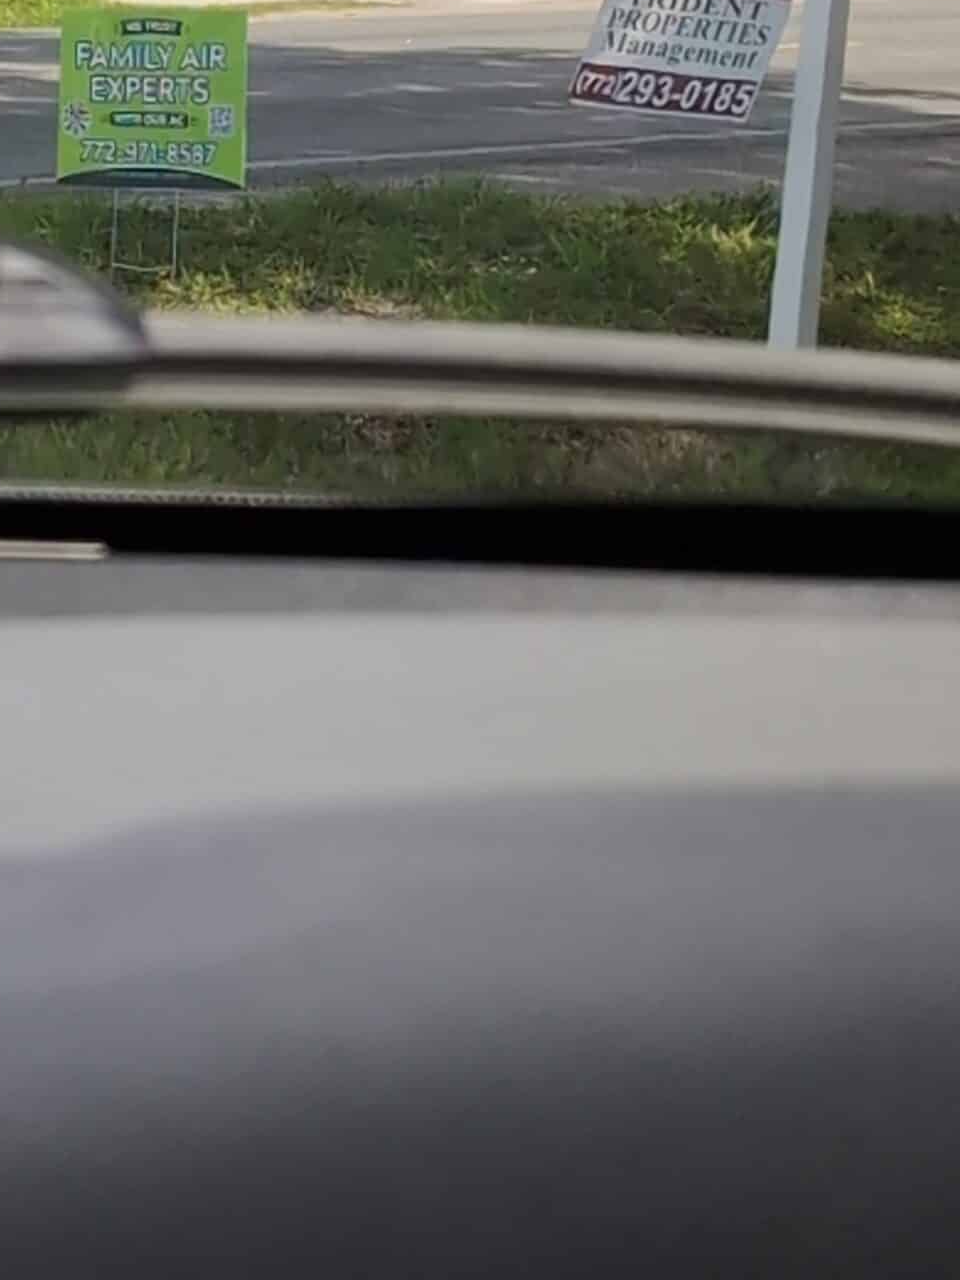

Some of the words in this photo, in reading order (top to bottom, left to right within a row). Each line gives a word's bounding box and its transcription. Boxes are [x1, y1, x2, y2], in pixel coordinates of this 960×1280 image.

[607, 8, 773, 47] PROPERTIES
[76, 41, 175, 70] FAMILY
[181, 42, 227, 71] AIR
[604, 32, 758, 70] Management
[90, 75, 210, 104] EXPERTS
